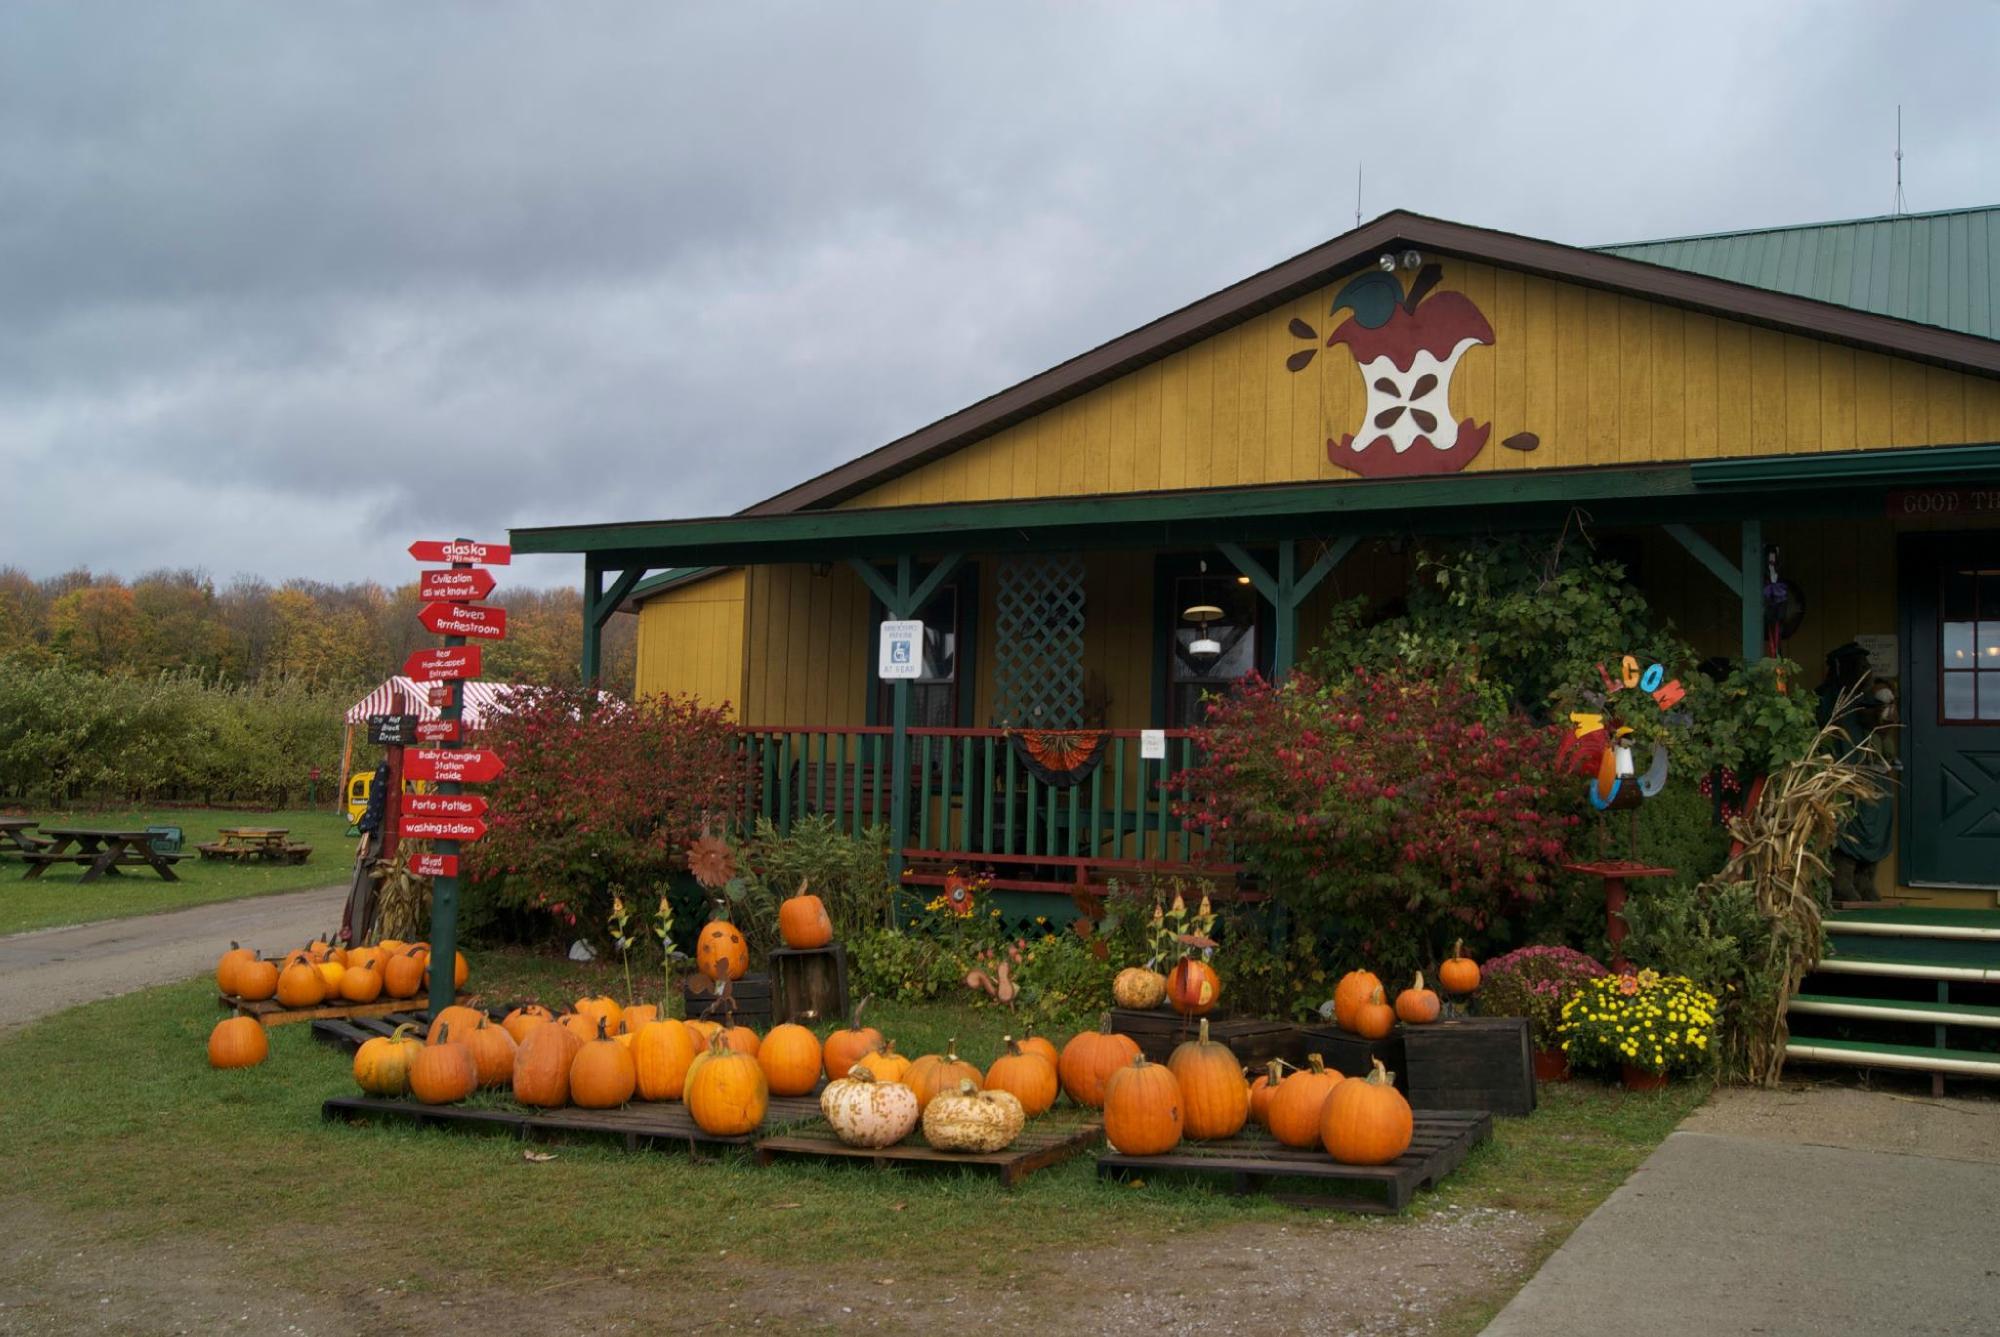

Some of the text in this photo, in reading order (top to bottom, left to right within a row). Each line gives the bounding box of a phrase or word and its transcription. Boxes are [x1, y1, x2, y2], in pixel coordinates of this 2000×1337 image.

[1903, 491, 1960, 513] GOOD
[442, 543, 487, 556] alaska
[431, 573, 473, 584] Civilization
[423, 588, 433, 597] as
[434, 588, 446, 597] we
[447, 586, 468, 596] know
[453, 606, 486, 620] Rovers
[429, 669, 458, 678] Entrance
[419, 751, 481, 763] Baby Changing
[435, 762, 464, 770] Station
[435, 772, 462, 780] Inside
[406, 823, 474, 834] washing station
